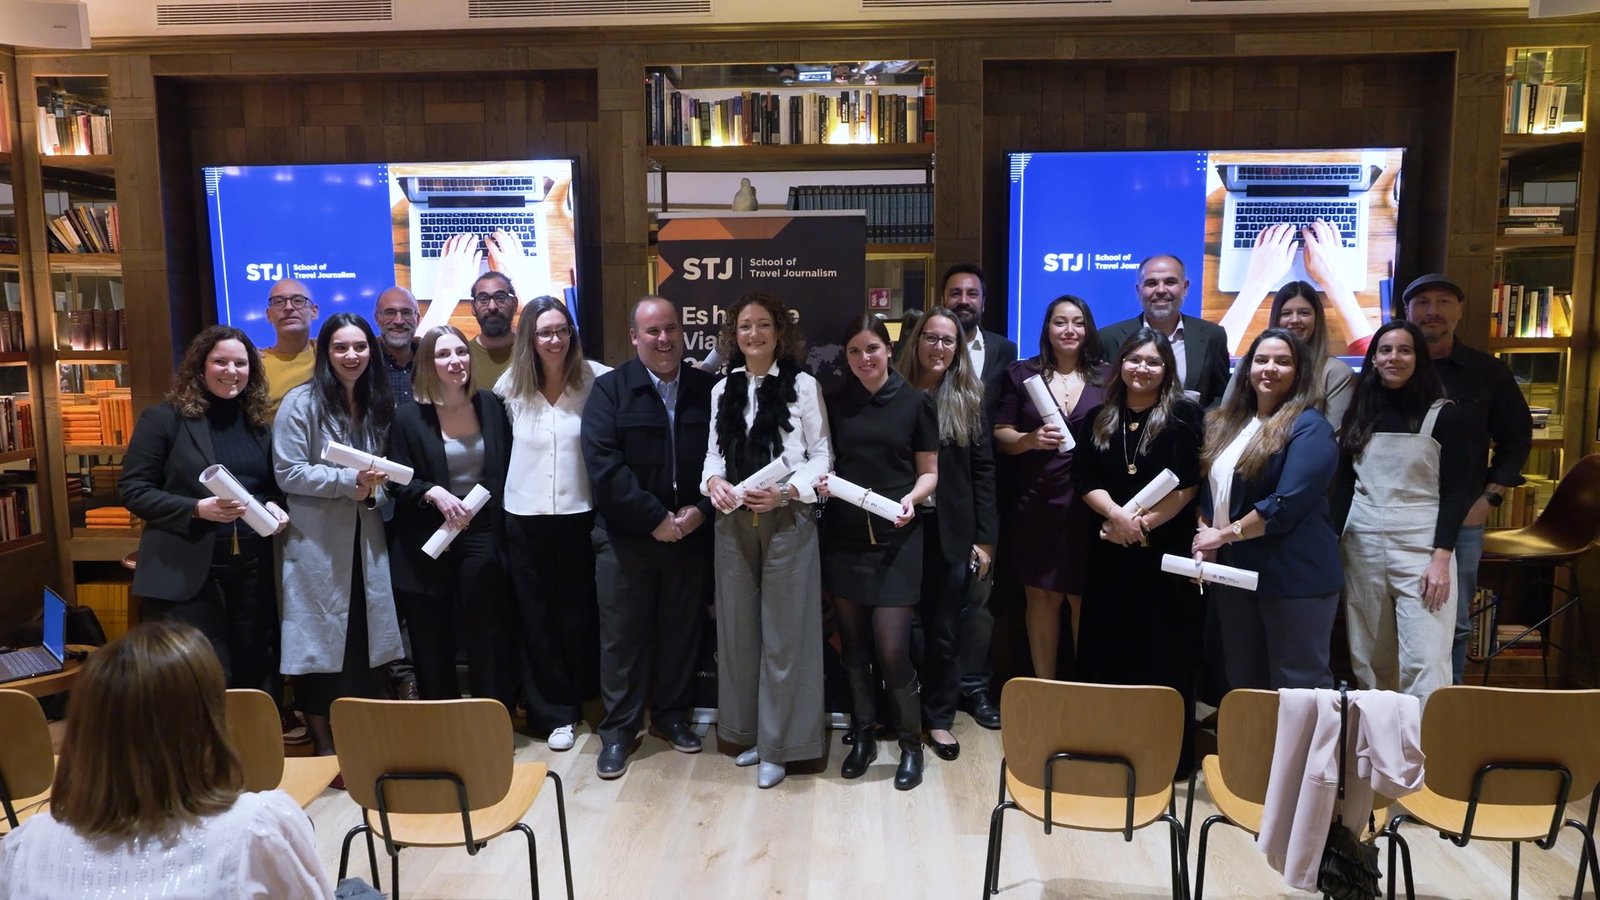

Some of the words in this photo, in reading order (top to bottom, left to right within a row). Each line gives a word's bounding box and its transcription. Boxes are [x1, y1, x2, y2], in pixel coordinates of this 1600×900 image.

[750, 258, 783, 266] School
[786, 257, 797, 266] of
[1043, 253, 1083, 271] STJ
[1122, 253, 1132, 261] of
[246, 263, 283, 281] STJ
[318, 263, 327, 271] of
[682, 257, 733, 280] STJ
[750, 269, 781, 278] Travel
[783, 268, 837, 278] Journalism
[293, 271, 317, 279] Travel
[318, 271, 356, 279] Journalism
[682, 306, 708, 325] Es
[682, 330, 723, 350] Via
